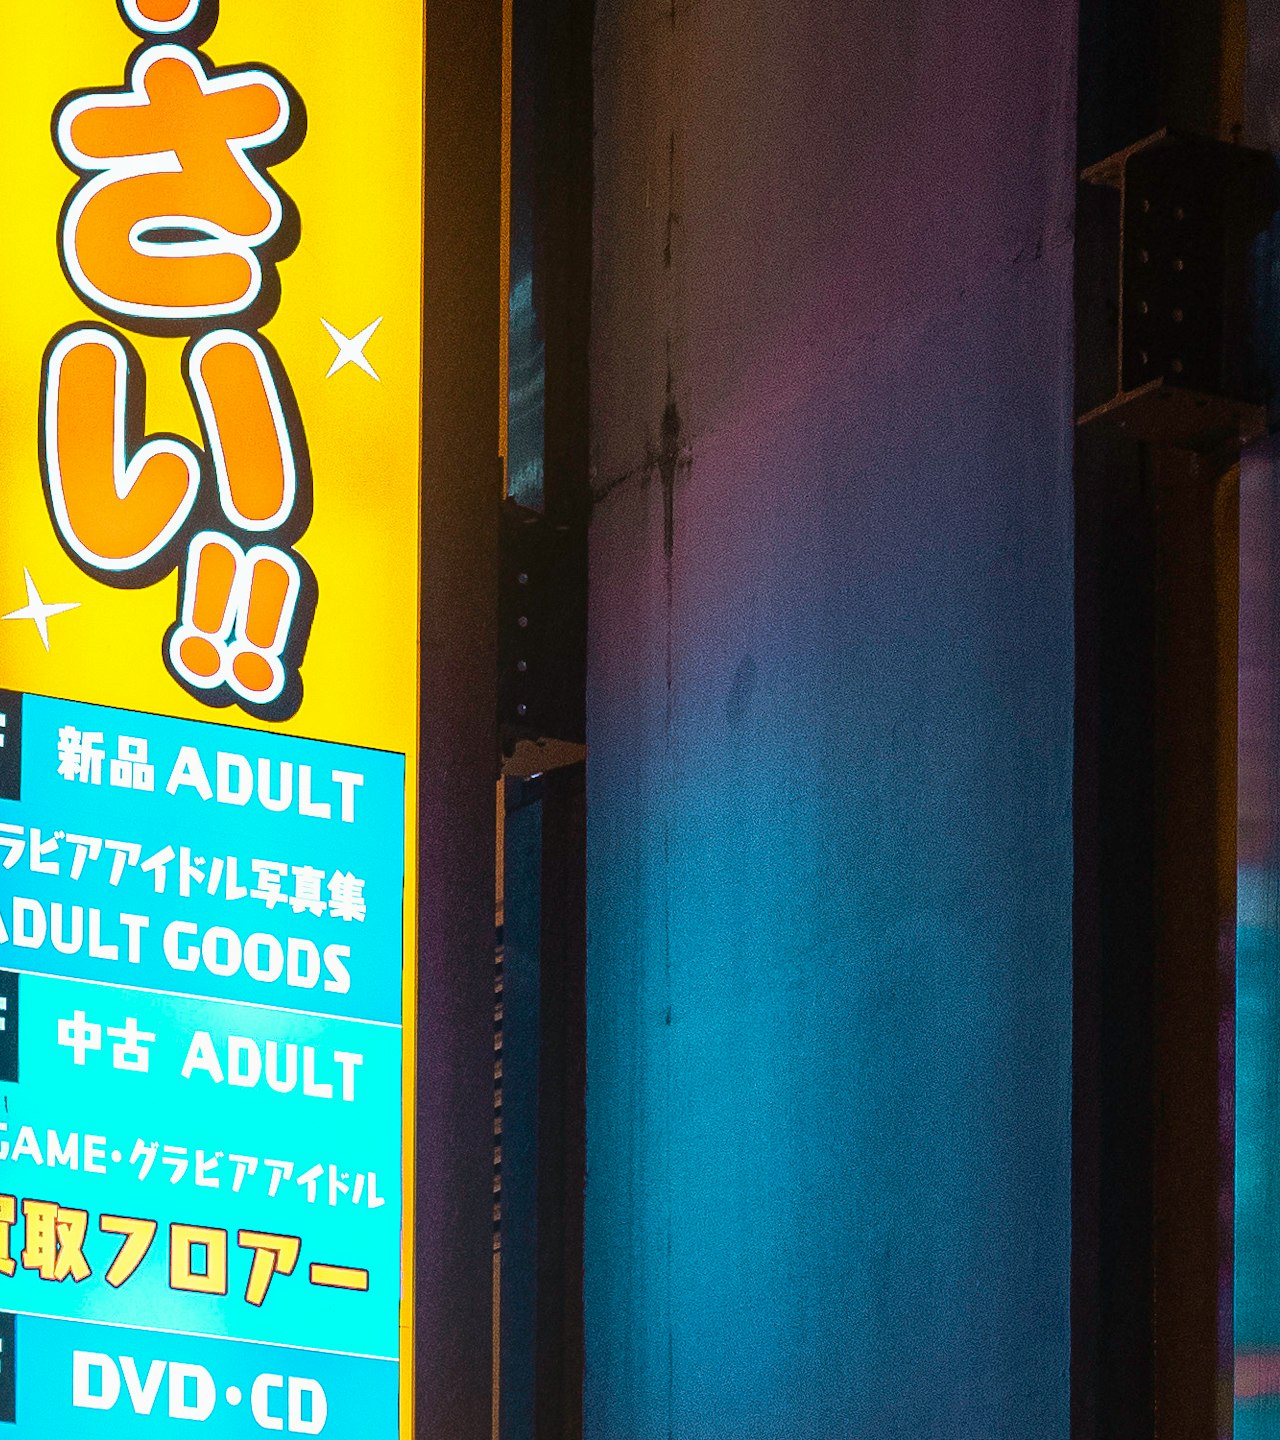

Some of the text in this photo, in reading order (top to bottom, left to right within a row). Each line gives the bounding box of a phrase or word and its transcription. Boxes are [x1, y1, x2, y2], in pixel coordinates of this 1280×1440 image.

[38, 0, 315, 718] さい!!
[57, 725, 364, 824] 新品 ADULT
[162, 918, 352, 997] GOODS
[57, 1014, 362, 1103] 中古 ADULT
